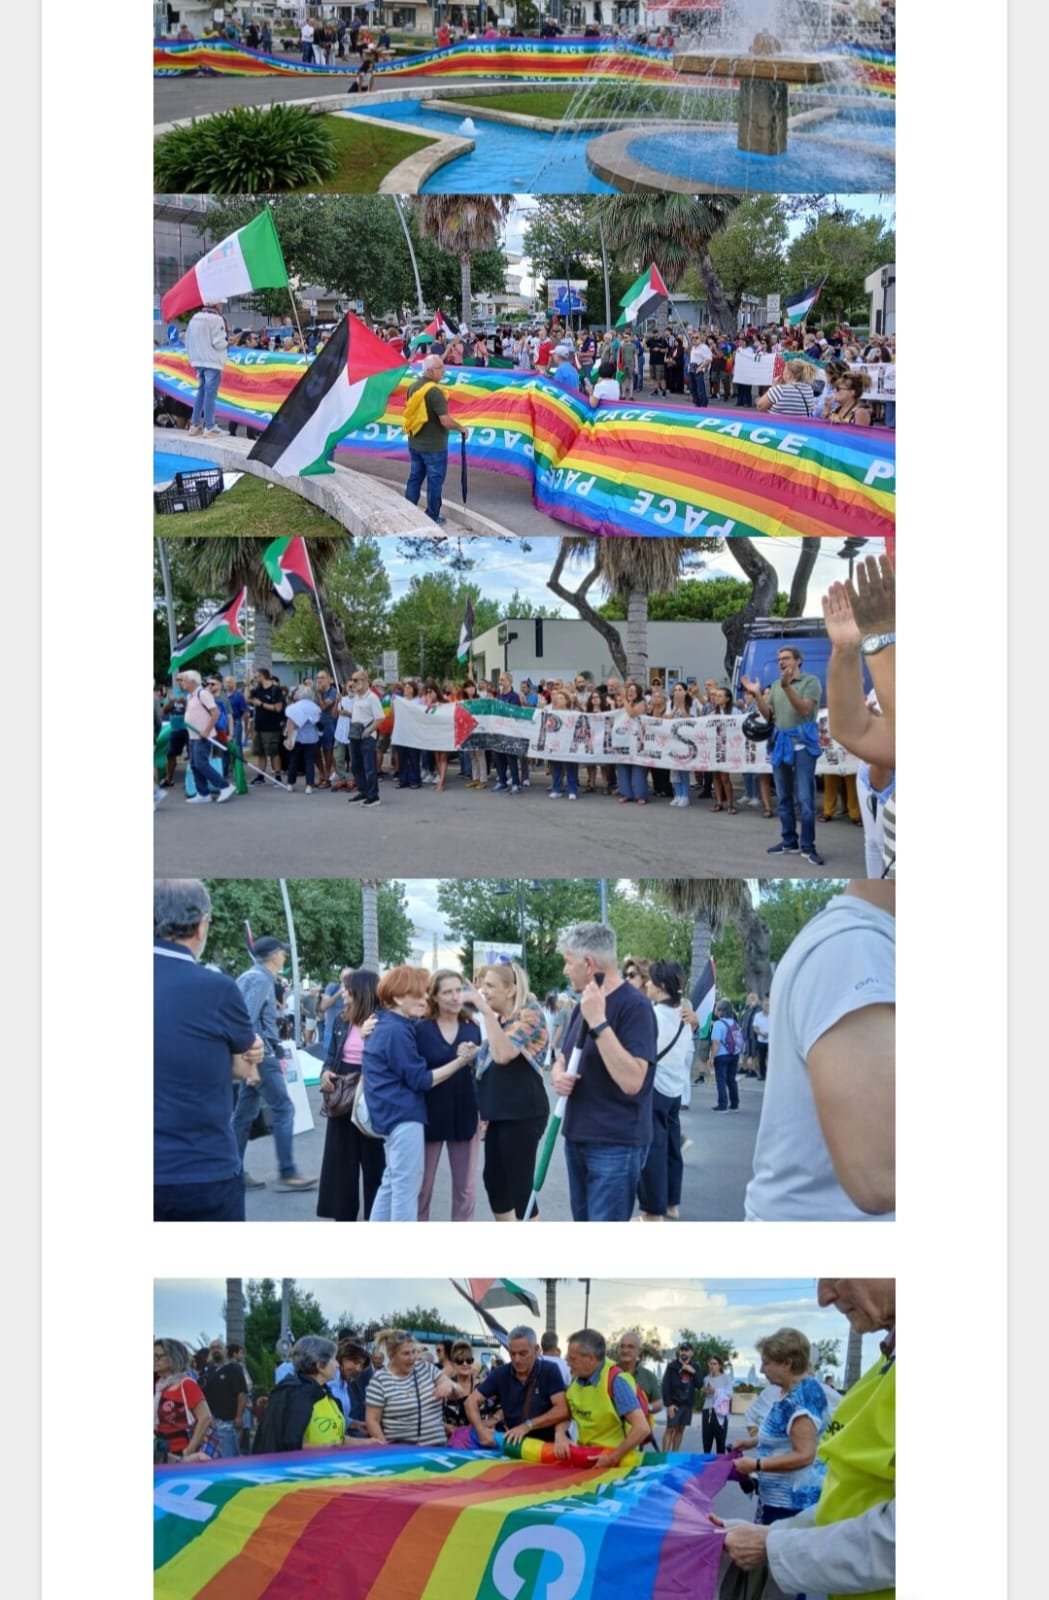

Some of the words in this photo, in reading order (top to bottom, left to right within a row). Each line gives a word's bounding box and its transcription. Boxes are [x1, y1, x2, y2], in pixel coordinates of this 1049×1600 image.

[425, 48, 454, 63] PACE
[467, 44, 496, 53] PACE
[510, 44, 539, 54] PACE
[554, 45, 585, 54] PACE
[232, 351, 271, 365] ACE
[593, 409, 660, 423] PACE
[695, 417, 809, 455] PACE
[863, 459, 896, 486] P
[629, 490, 736, 537] PACE
